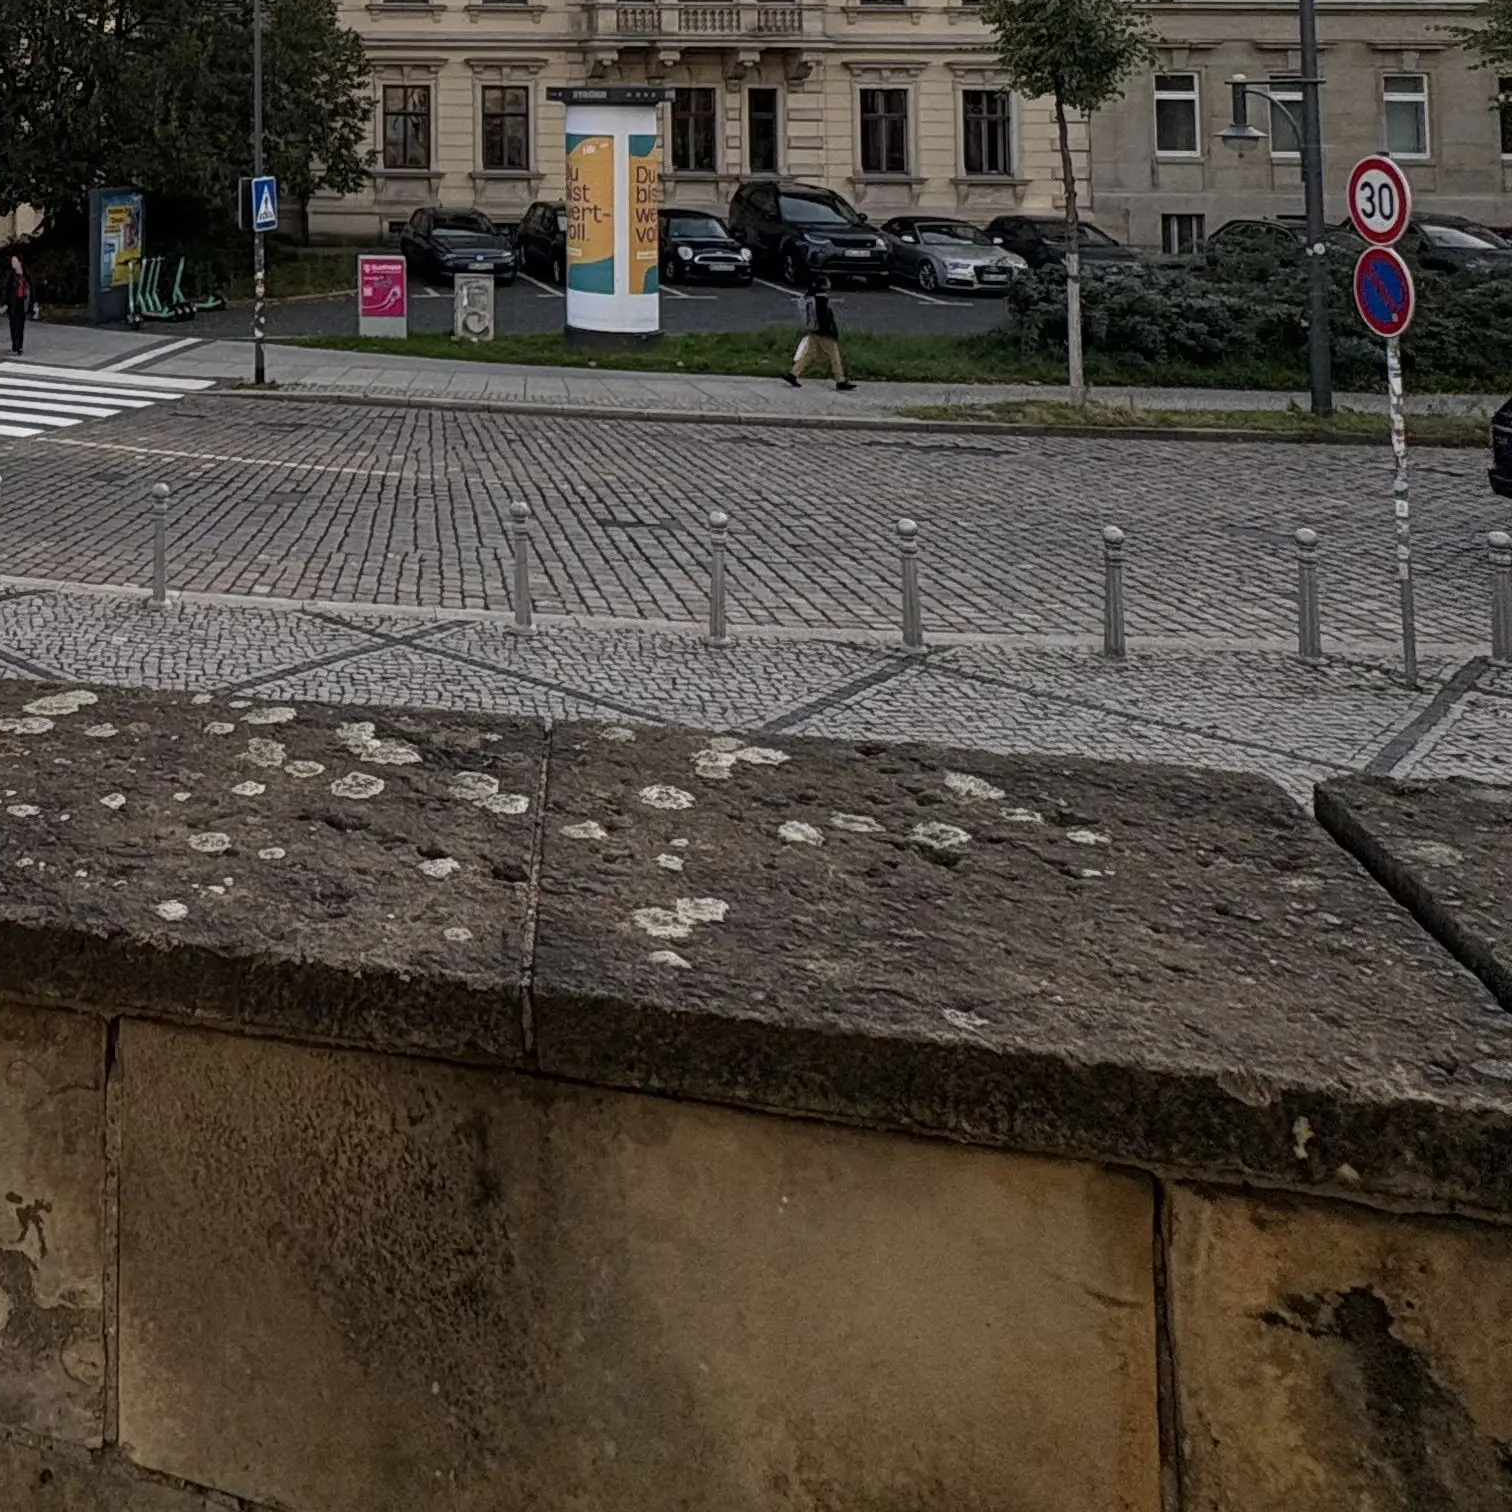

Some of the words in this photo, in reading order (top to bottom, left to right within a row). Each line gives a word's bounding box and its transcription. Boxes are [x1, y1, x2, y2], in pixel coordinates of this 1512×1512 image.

[635, 165, 657, 185] Du
[636, 186, 657, 204] bis
[1359, 180, 1395, 222] 30
[567, 205, 611, 223] ert-
[636, 207, 657, 224] we
[568, 223, 591, 243] oll.
